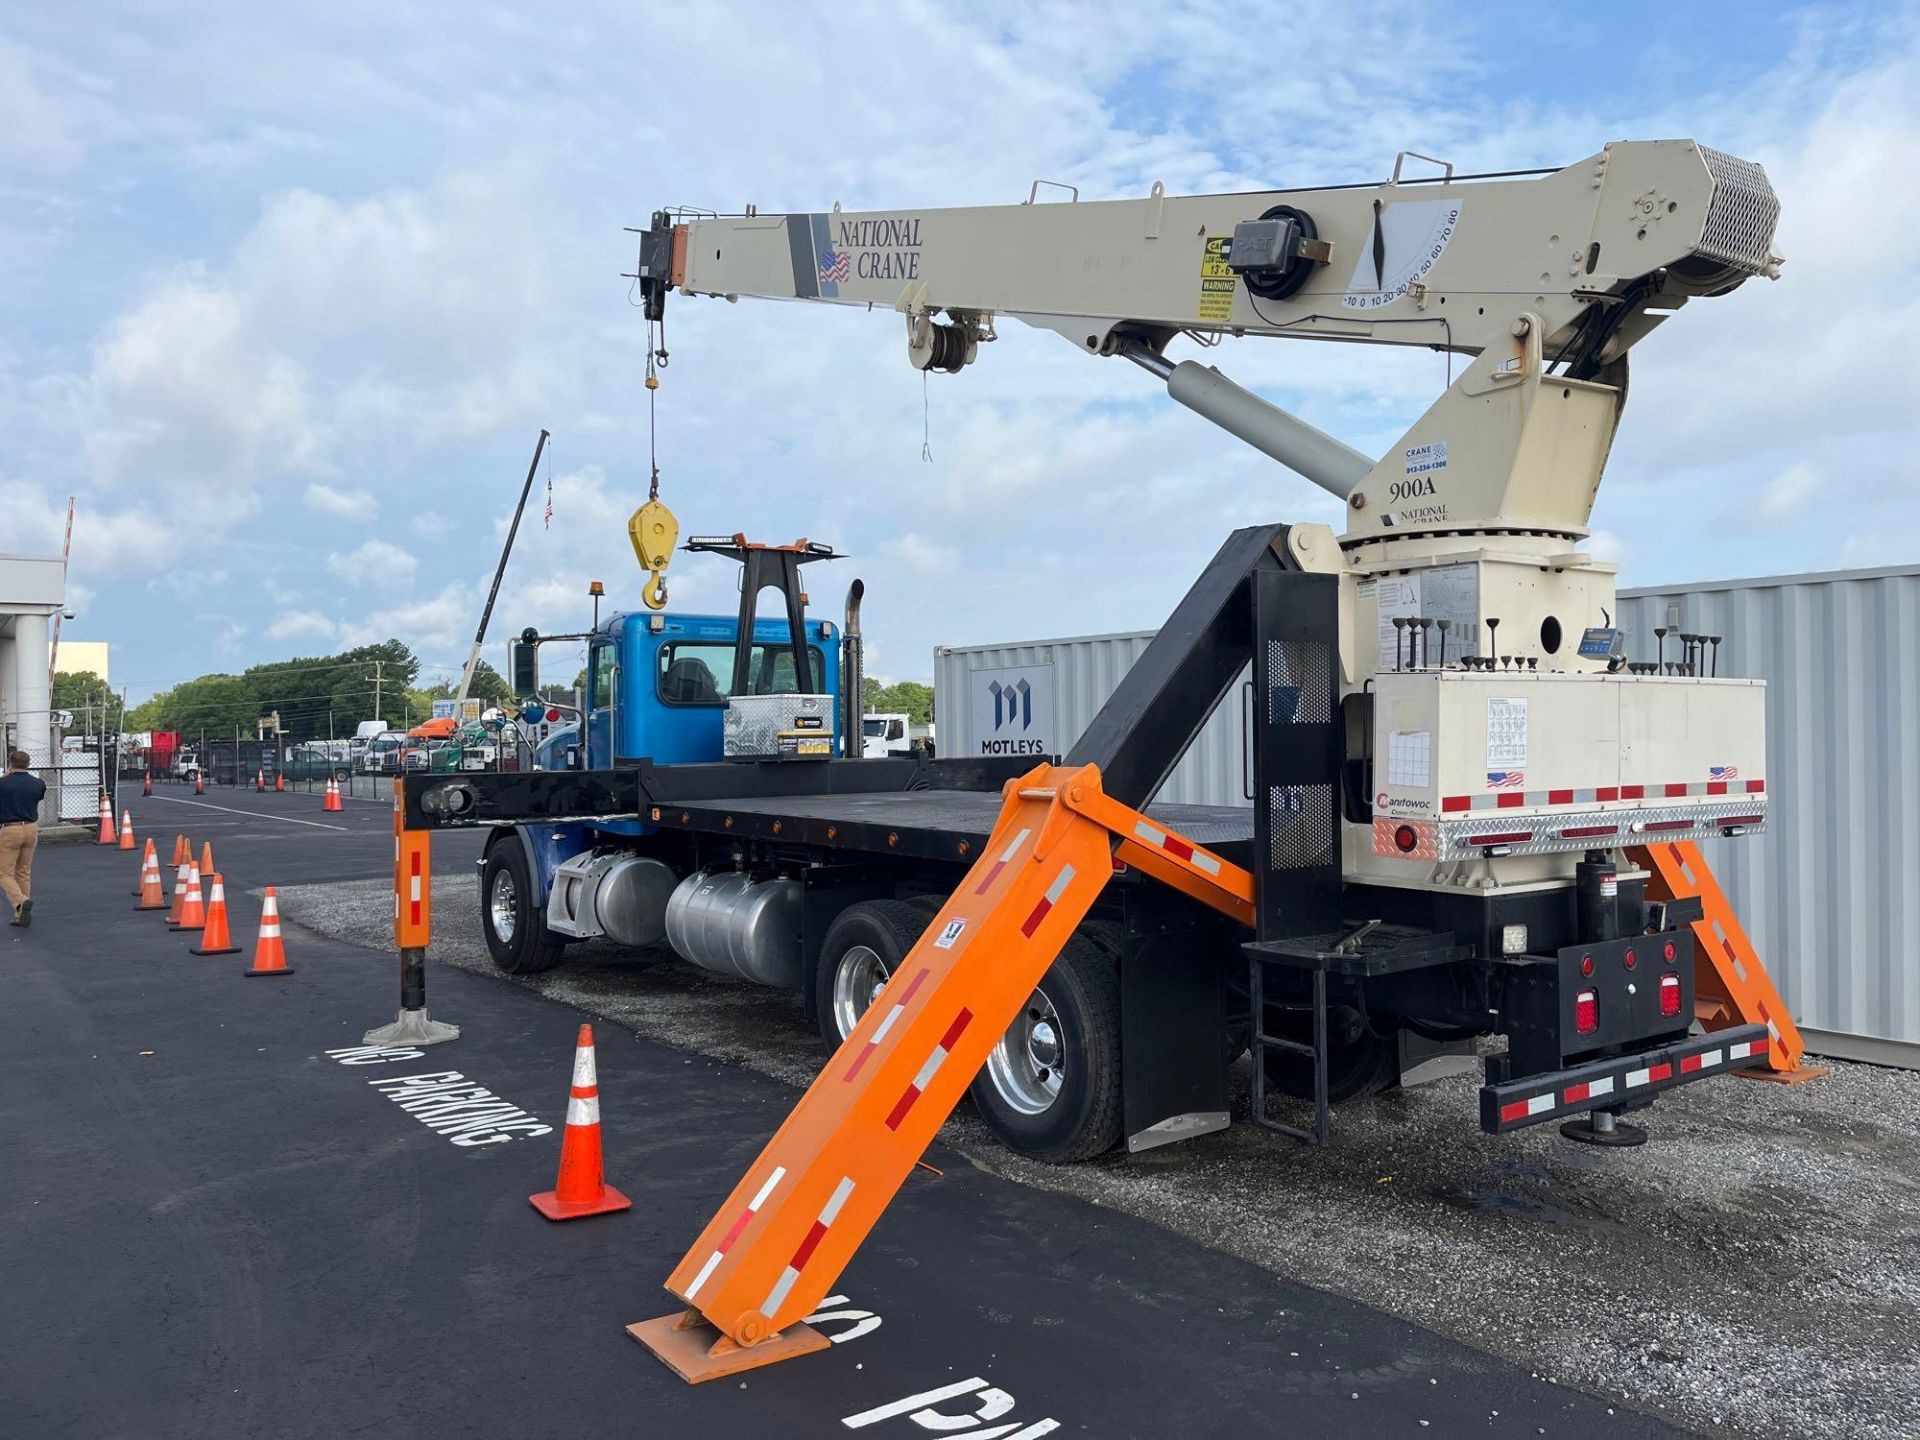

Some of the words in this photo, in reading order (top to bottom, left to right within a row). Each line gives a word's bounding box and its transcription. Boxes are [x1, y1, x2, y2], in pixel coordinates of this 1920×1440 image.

[1447, 209, 1458, 225] 80
[838, 218, 923, 247] NATIONAL
[1440, 227, 1452, 242] 70
[1431, 244, 1442, 259] 60
[858, 251, 920, 280] CRANE
[1420, 260, 1432, 274] 50
[1203, 281, 1235, 292] WARNING
[1396, 283, 1407, 297] 30
[1360, 298, 1366, 307] 0
[1371, 296, 1381, 306] 10
[1383, 291, 1394, 304] 20
[1406, 446, 1431, 457] CRANE
[1389, 477, 1437, 504] 900A
[1401, 505, 1448, 521] NATIONAL
[982, 739, 1043, 754] MOTLEYS
[1376, 793, 1431, 809] Manitowoc
[368, 1070, 554, 1147] PARKING
